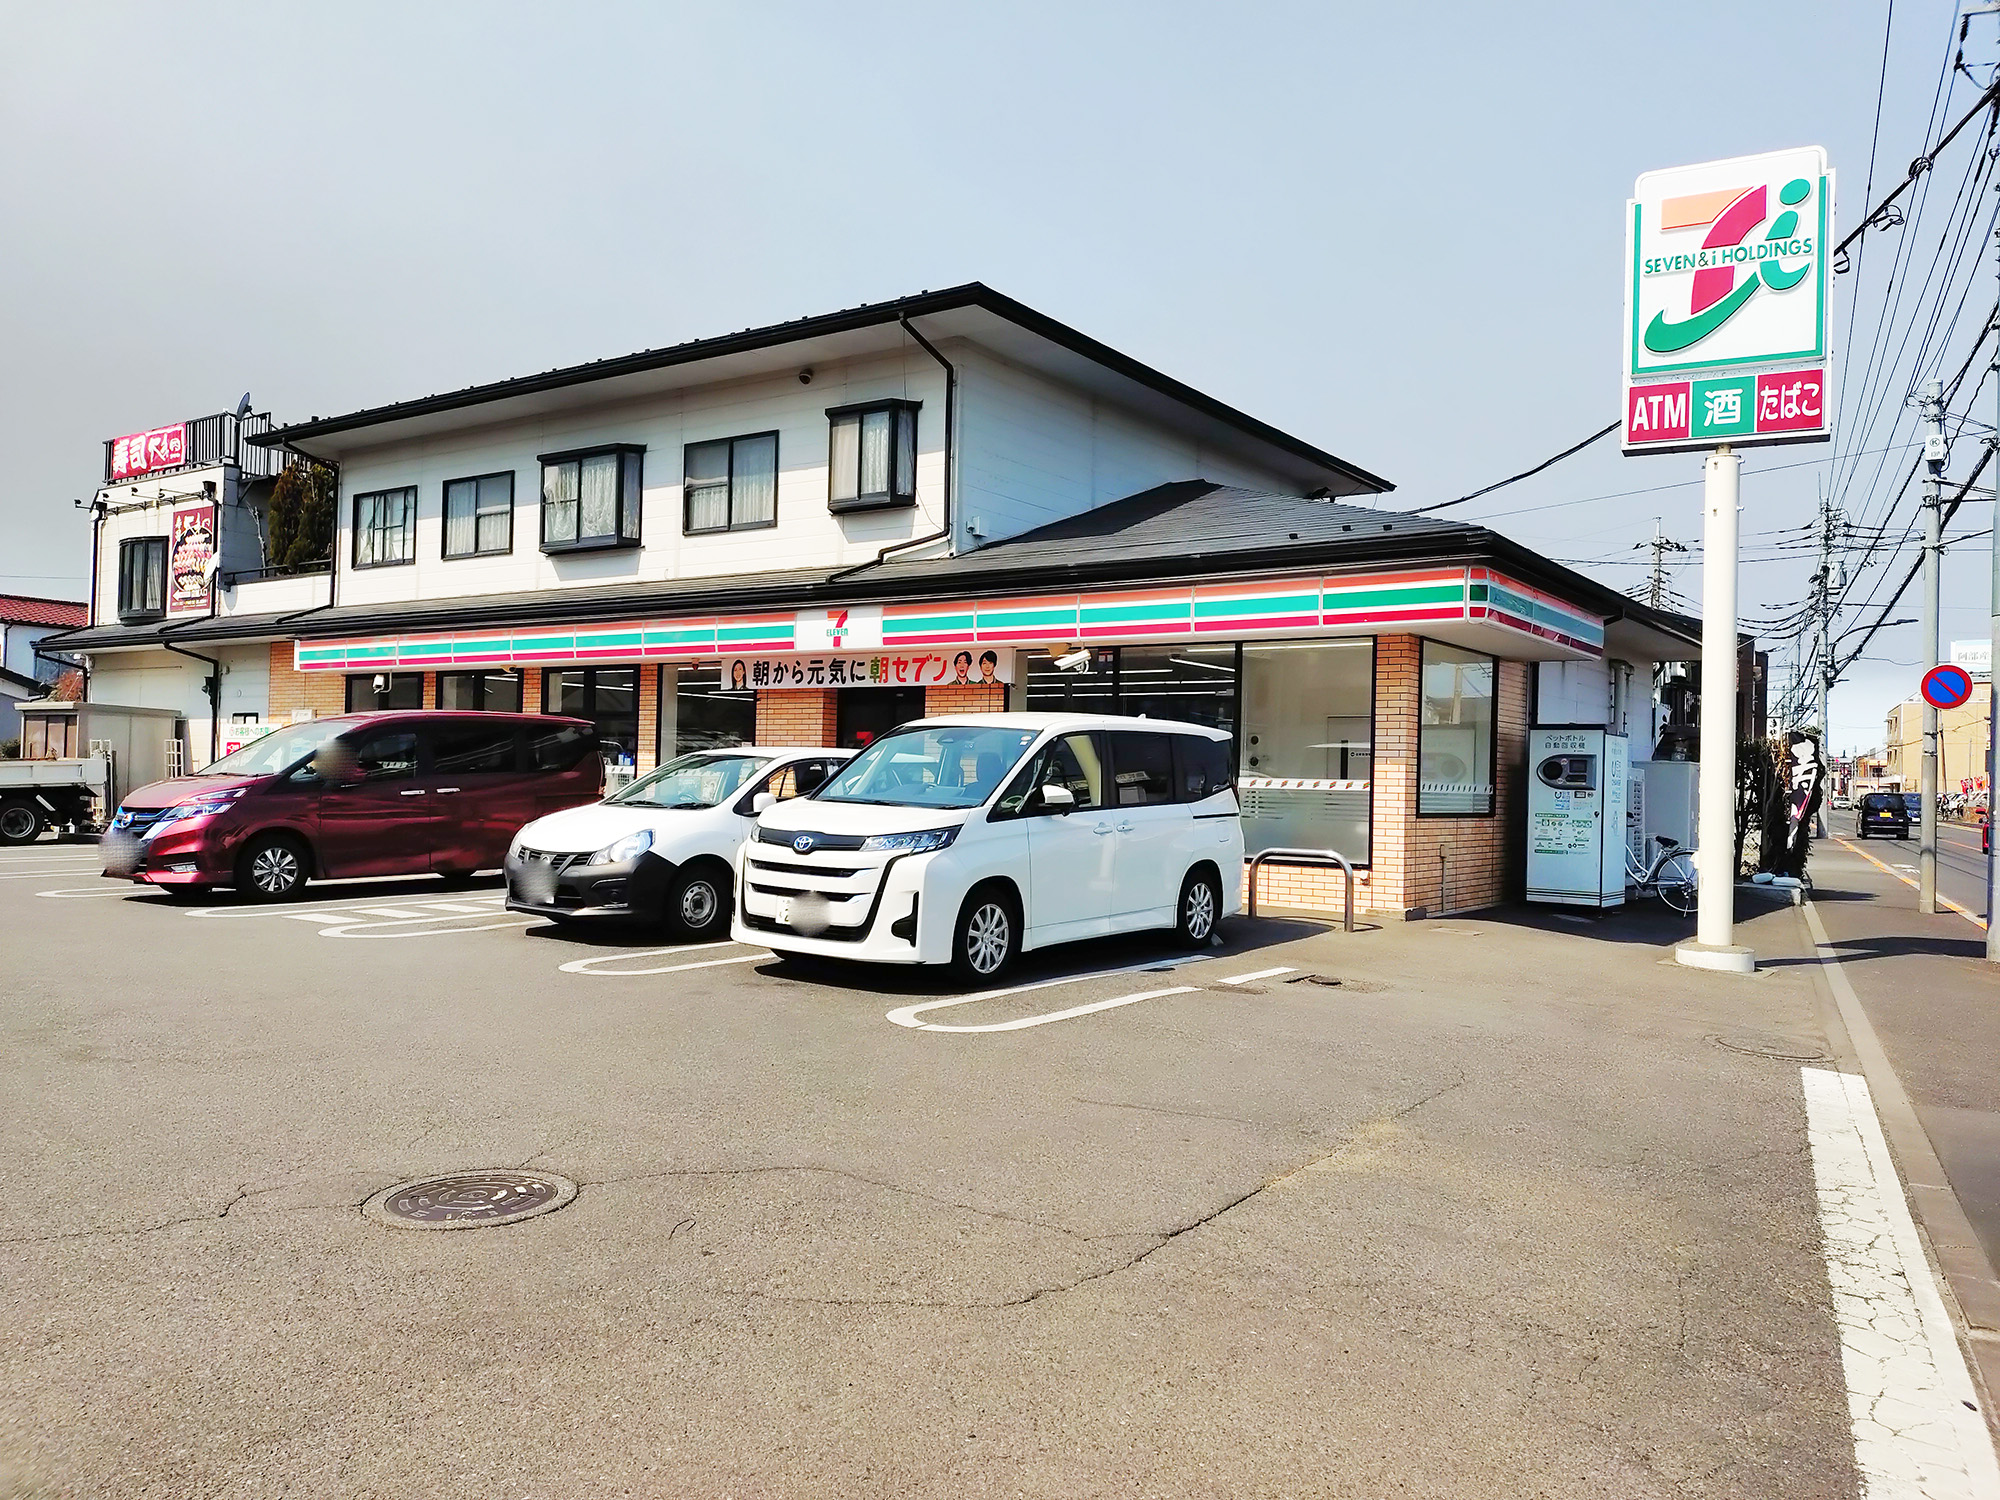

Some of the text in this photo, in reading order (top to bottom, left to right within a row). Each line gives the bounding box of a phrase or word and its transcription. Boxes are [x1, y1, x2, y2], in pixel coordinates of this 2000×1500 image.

[1722, 238, 1813, 262] HOLDINGS
[1631, 393, 1686, 432] ATM
[1703, 388, 1743, 427] 酒
[1760, 380, 1821, 421] たばこ
[752, 653, 948, 686] 朝から元気に朝セブン
[1545, 734, 1586, 742] ペットボトル
